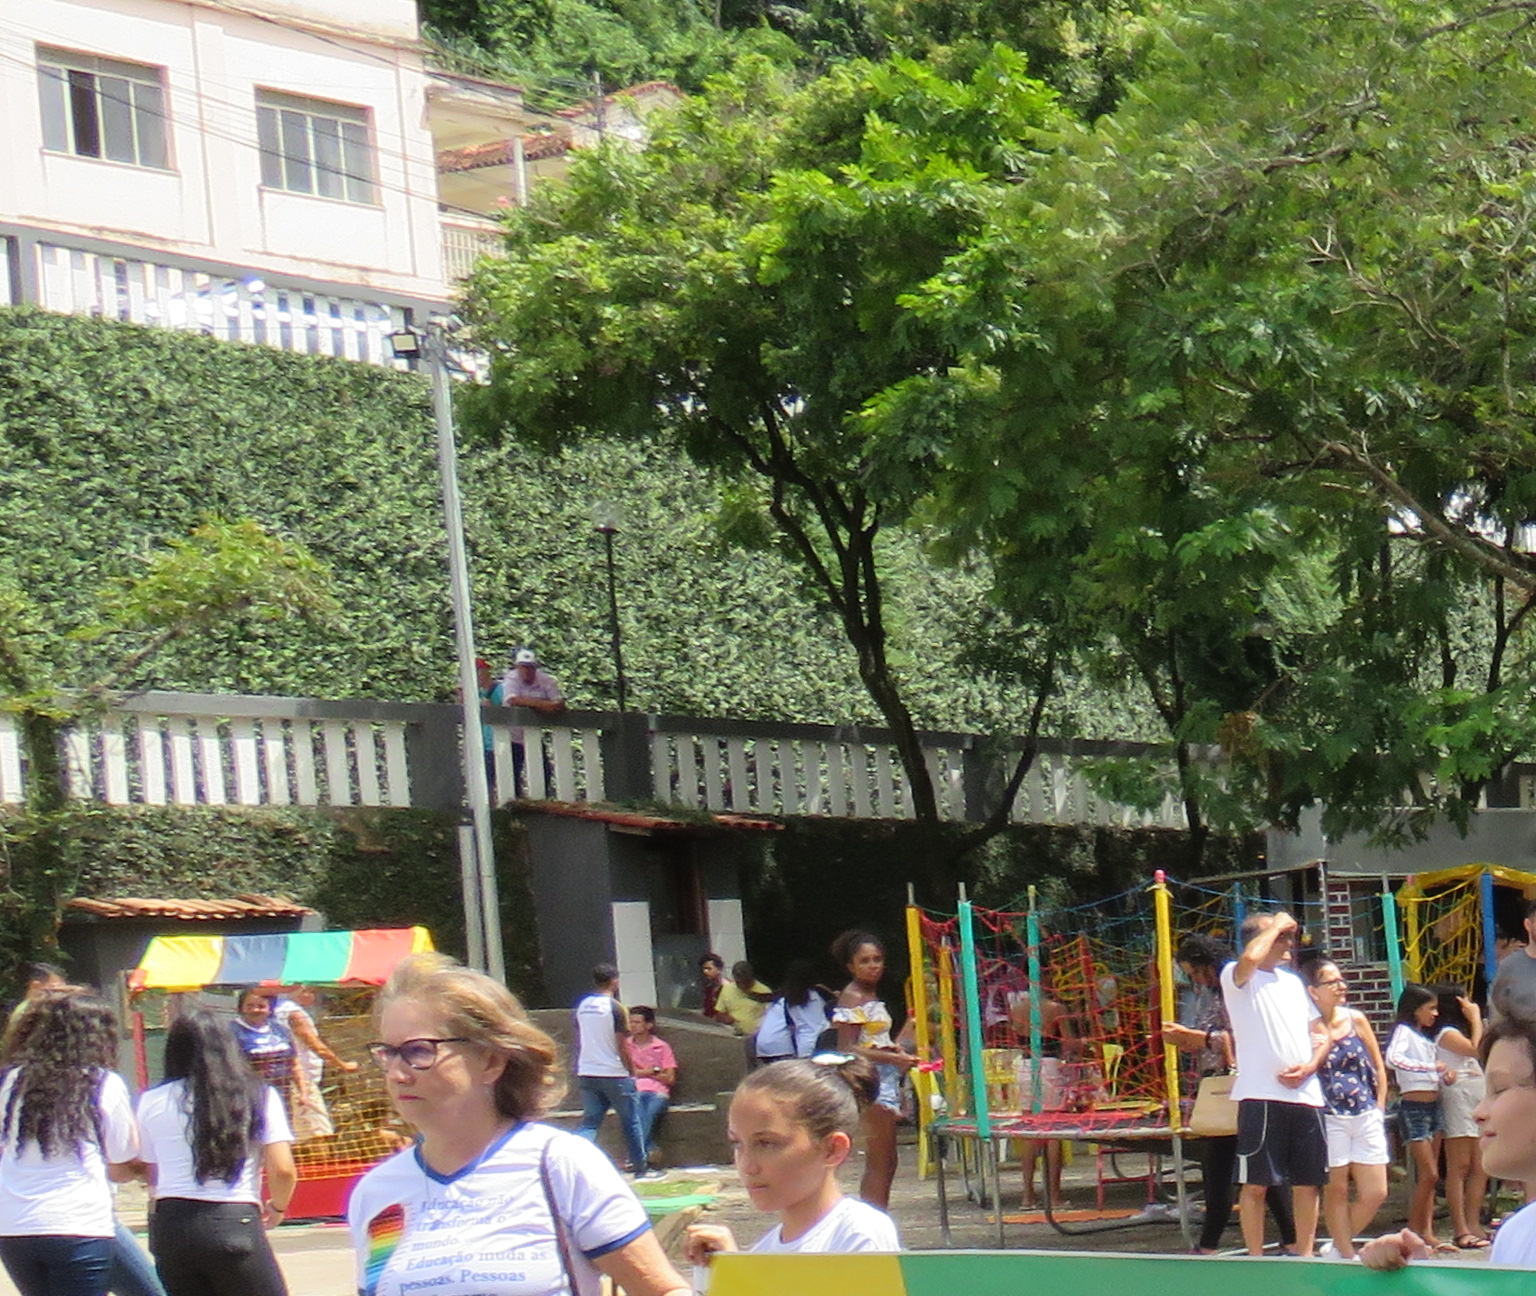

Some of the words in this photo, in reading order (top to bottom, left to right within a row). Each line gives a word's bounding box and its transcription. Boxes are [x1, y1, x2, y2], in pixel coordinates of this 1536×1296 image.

[406, 1252, 475, 1272] Educação
[478, 1251, 527, 1262] muda
[530, 1251, 547, 1262] as
[460, 1269, 527, 1284] Pessoas
